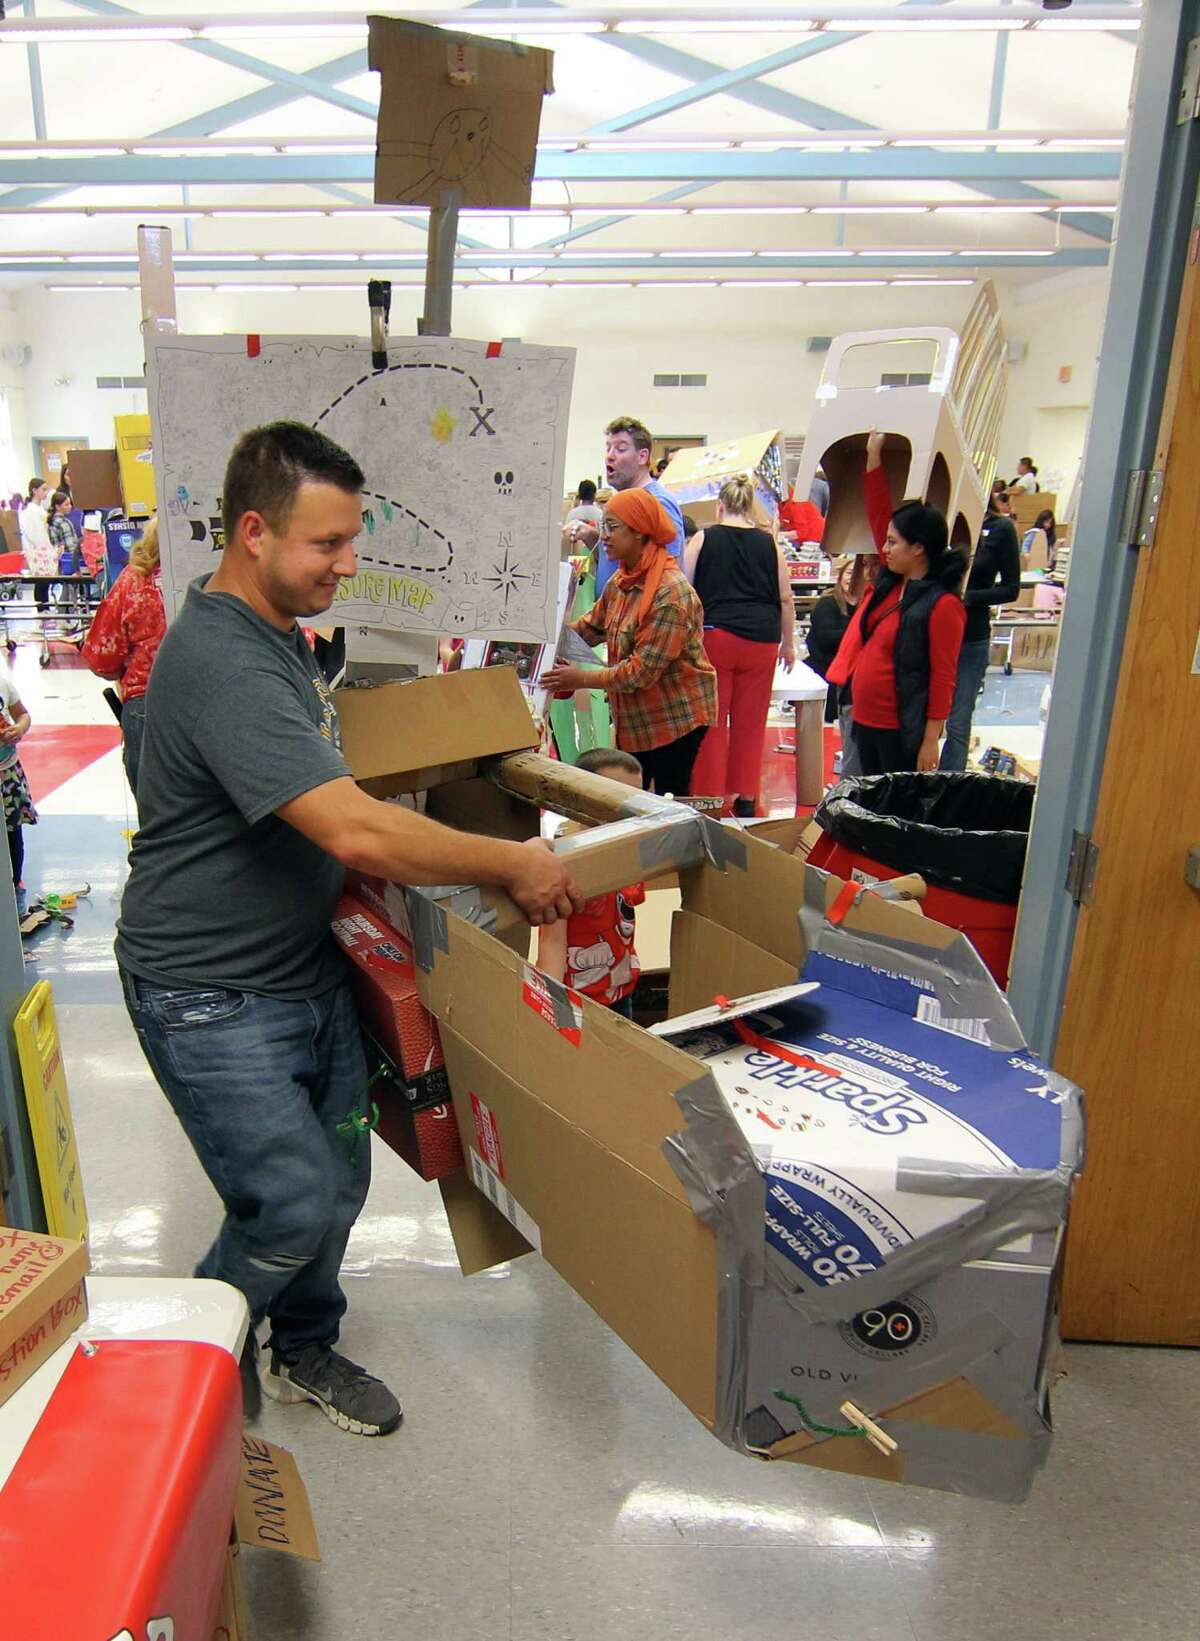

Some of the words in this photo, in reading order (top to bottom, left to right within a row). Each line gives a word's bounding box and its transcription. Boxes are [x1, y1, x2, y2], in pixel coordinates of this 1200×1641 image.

[816, 1032, 848, 1046] SIZE
[847, 1042, 859, 1050] &
[858, 1048, 916, 1073] QUALITY
[916, 1060, 949, 1077] FOR
[743, 1051, 928, 1136] Sparkle
[914, 1070, 963, 1092] RIGHT
[763, 1160, 826, 1189] WRAPP
[769, 1185, 836, 1247] FULL-SIZE
[828, 1186, 904, 1249] DIVIDUALLY
[765, 1211, 812, 1261] WRAPP
[835, 1244, 877, 1278] 70
[0, 1326, 46, 1382] stion
[790, 1366, 832, 1381] OLD
[243, 1437, 291, 1546] DONATE
